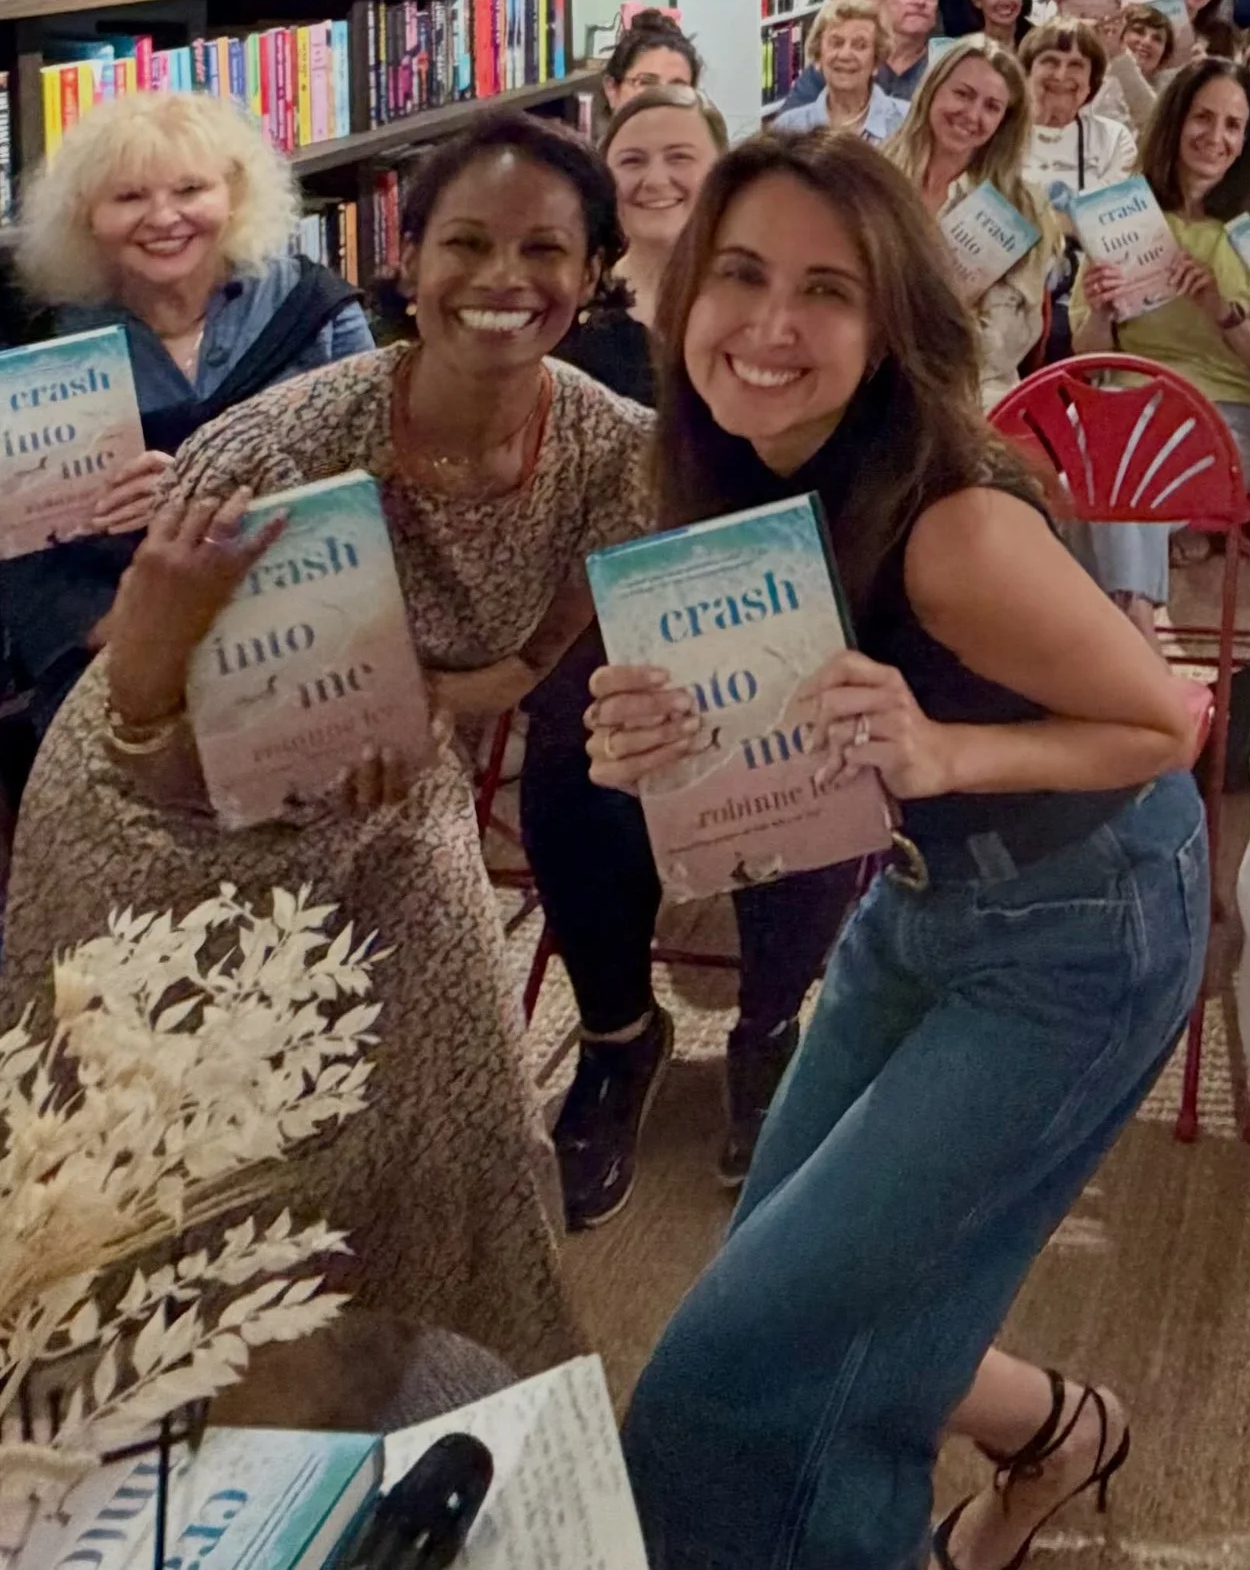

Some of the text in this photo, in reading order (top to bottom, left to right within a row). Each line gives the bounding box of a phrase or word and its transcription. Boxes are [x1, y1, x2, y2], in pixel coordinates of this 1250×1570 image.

[976, 209, 1016, 253] crash
[1098, 195, 1148, 226] crash
[950, 221, 981, 255] into
[1101, 230, 1140, 253] into
[1137, 245, 1165, 267] me
[9, 366, 112, 413] crash
[3, 423, 77, 458] into
[61, 449, 116, 481] me
[248, 534, 360, 598] rash
[658, 568, 800, 644] crash
[211, 621, 316, 677] into
[297, 662, 375, 710] me
[692, 666, 758, 713] nto
[699, 789, 804, 830] robinne
